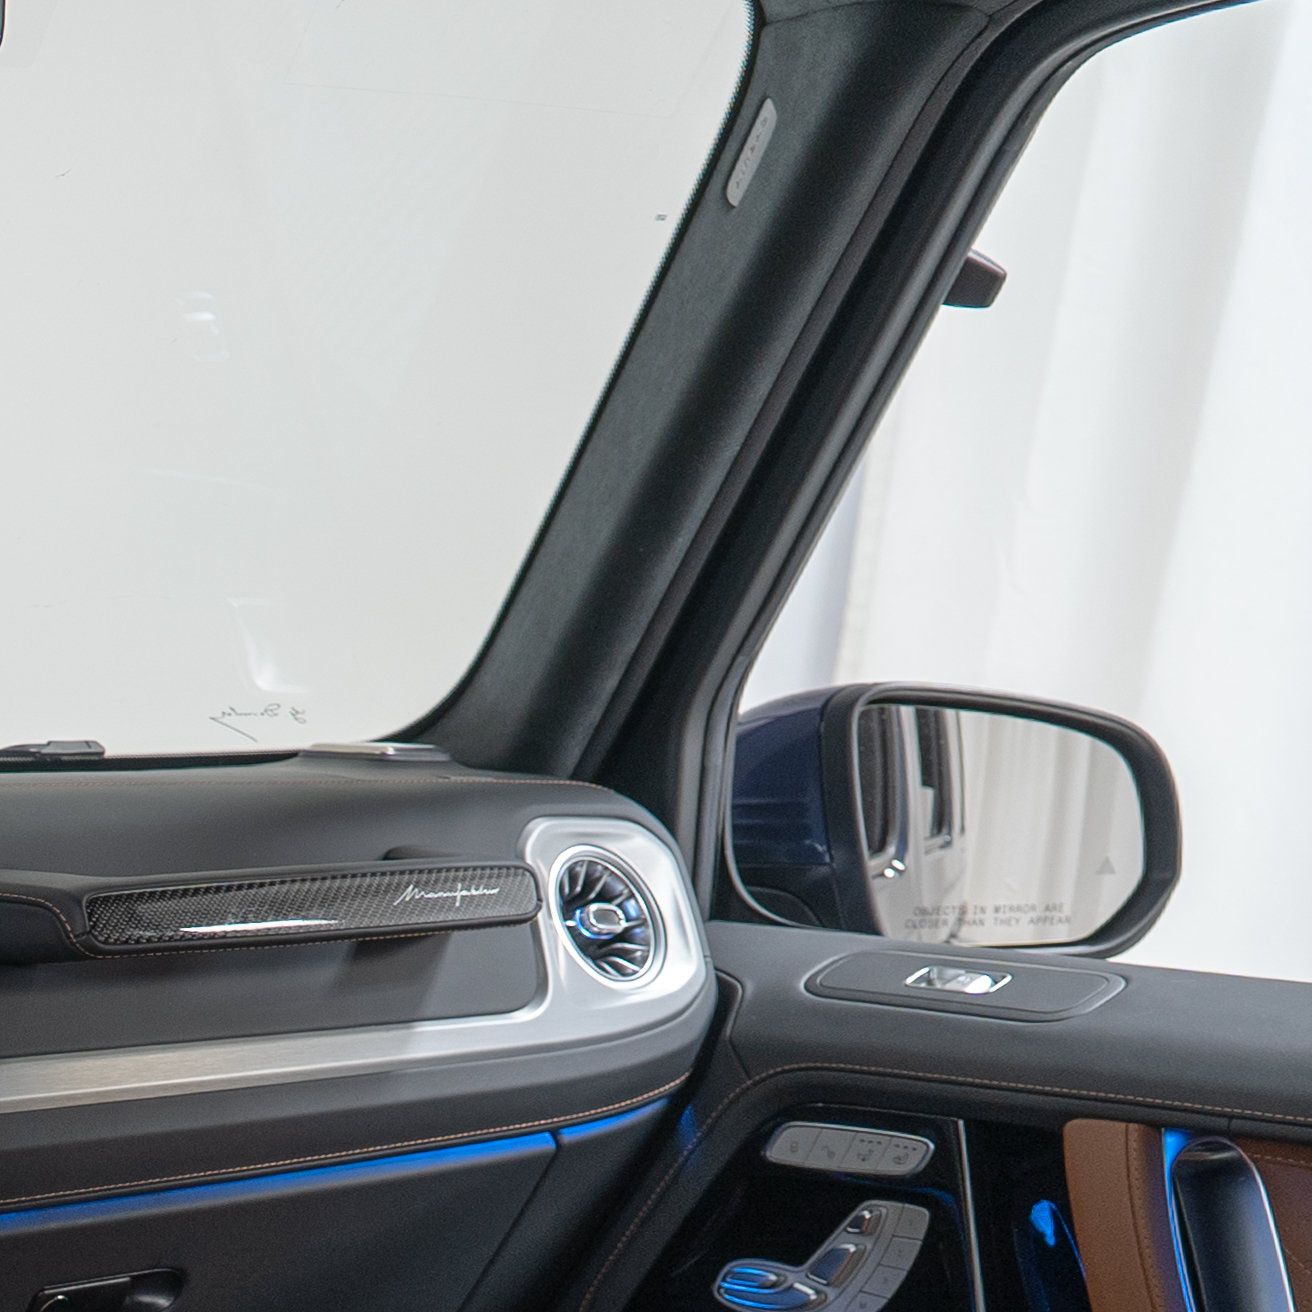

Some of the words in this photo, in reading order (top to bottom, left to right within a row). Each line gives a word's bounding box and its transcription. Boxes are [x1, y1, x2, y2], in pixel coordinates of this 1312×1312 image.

[913, 904, 967, 917] OBJECTS
[973, 904, 987, 915] IN
[993, 903, 1037, 915] MIRROR
[1044, 902, 1065, 913] ARE
[905, 918, 949, 930] CLOSER
[993, 916, 1021, 927] THEY
[1027, 915, 1072, 926] APPEAR
